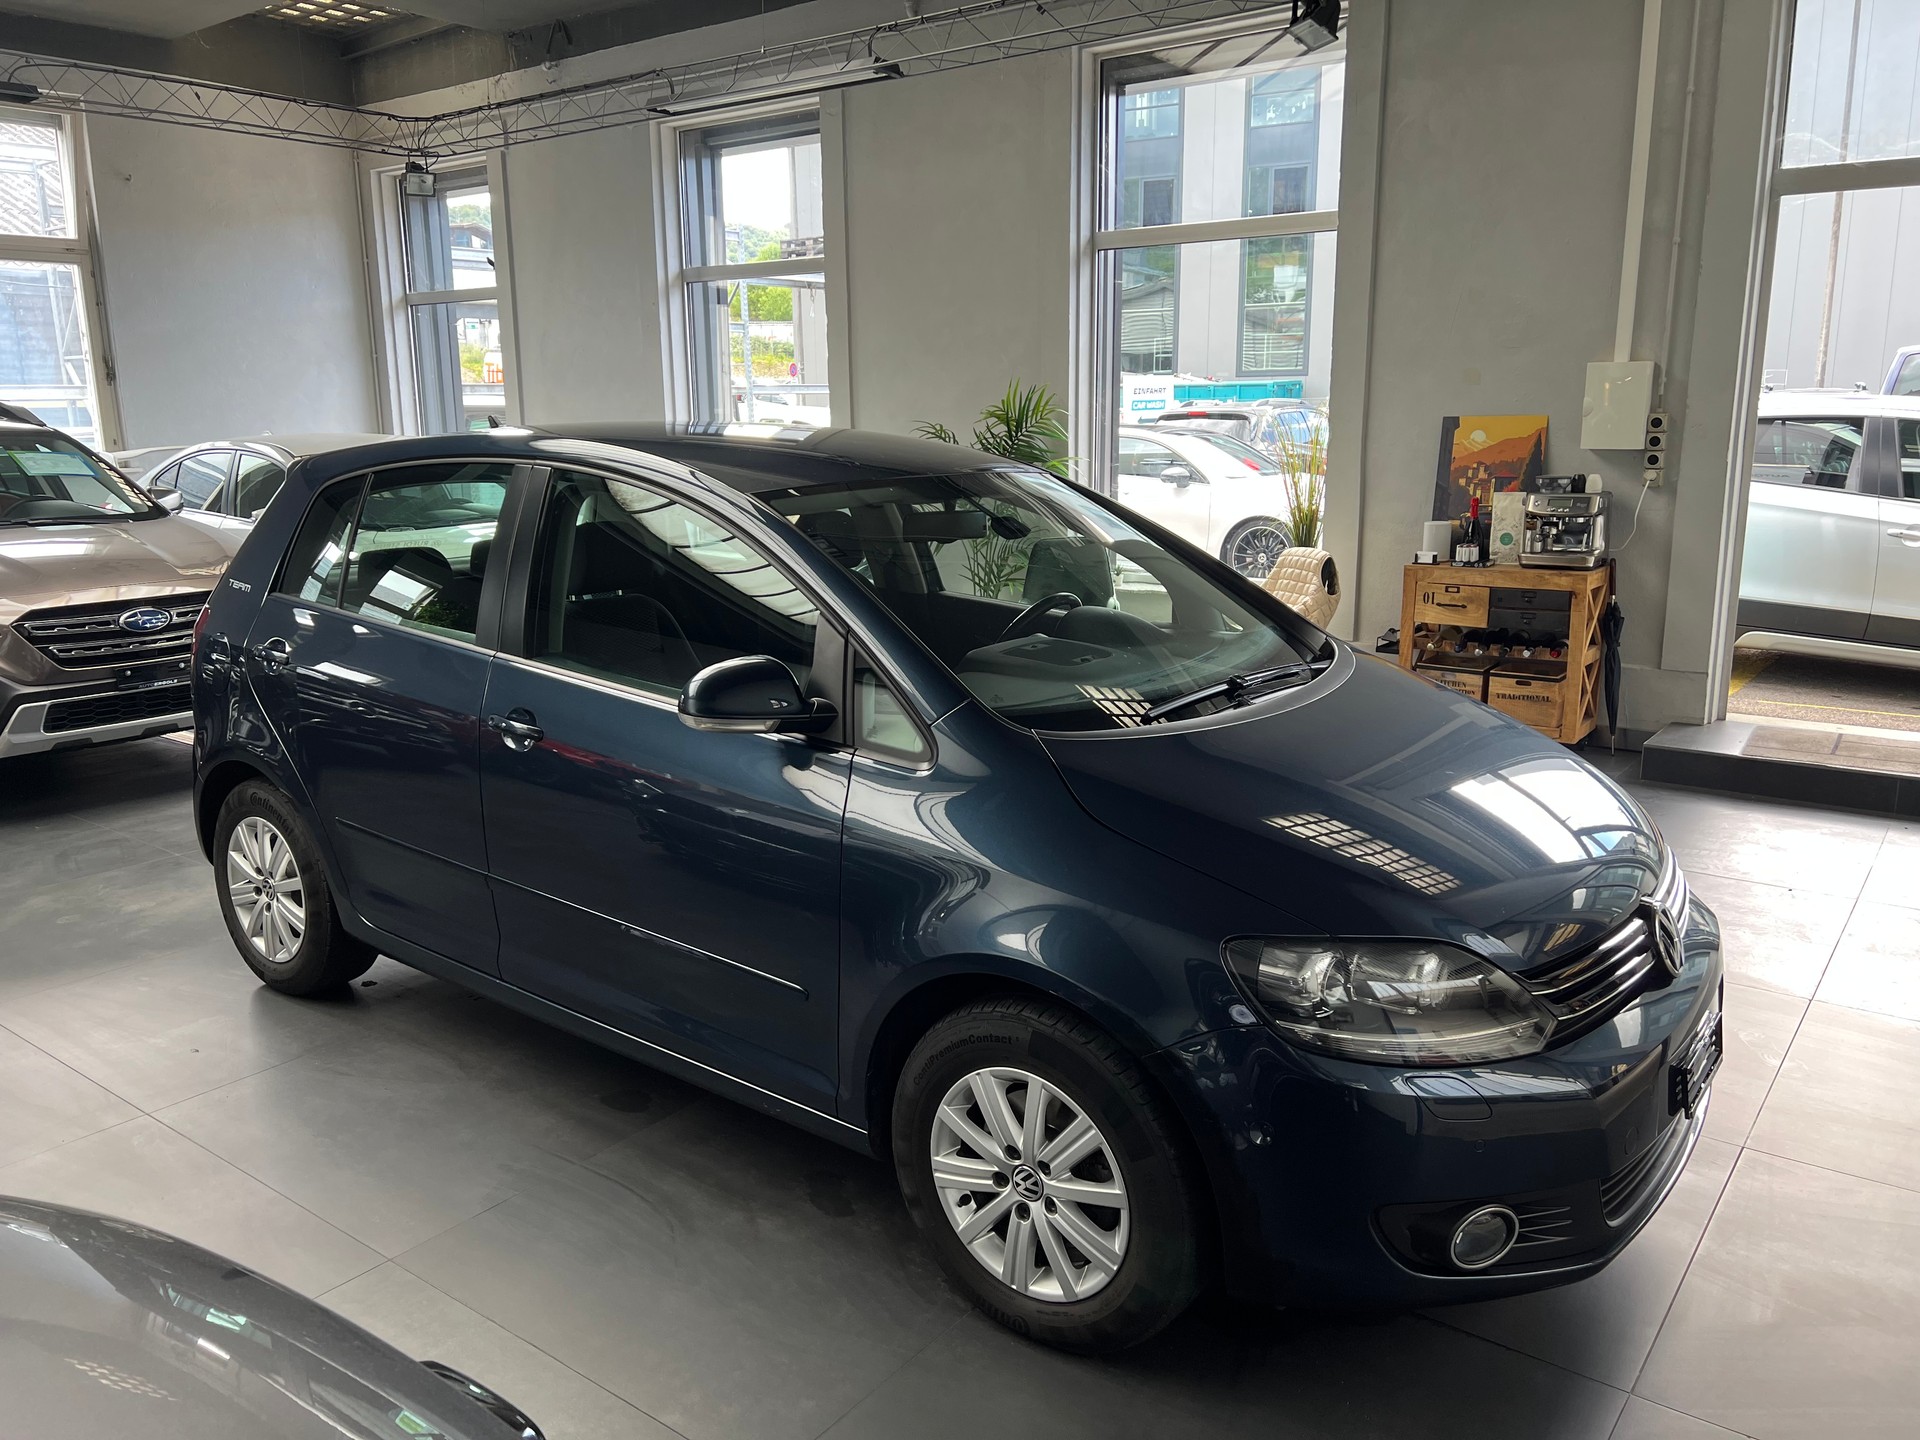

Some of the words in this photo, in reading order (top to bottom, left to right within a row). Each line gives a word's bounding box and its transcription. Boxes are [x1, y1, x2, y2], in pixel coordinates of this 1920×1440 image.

[1133, 387, 1167, 395] EINFAHRT
[1132, 401, 1146, 410] CAR
[1147, 401, 1164, 409] WASH
[229, 578, 251, 593] TEAM
[1435, 679, 1467, 688] ITCHEN
[1496, 692, 1551, 703] TRADITIONAL
[913, 1033, 1013, 1086] ContiPremiumContact
